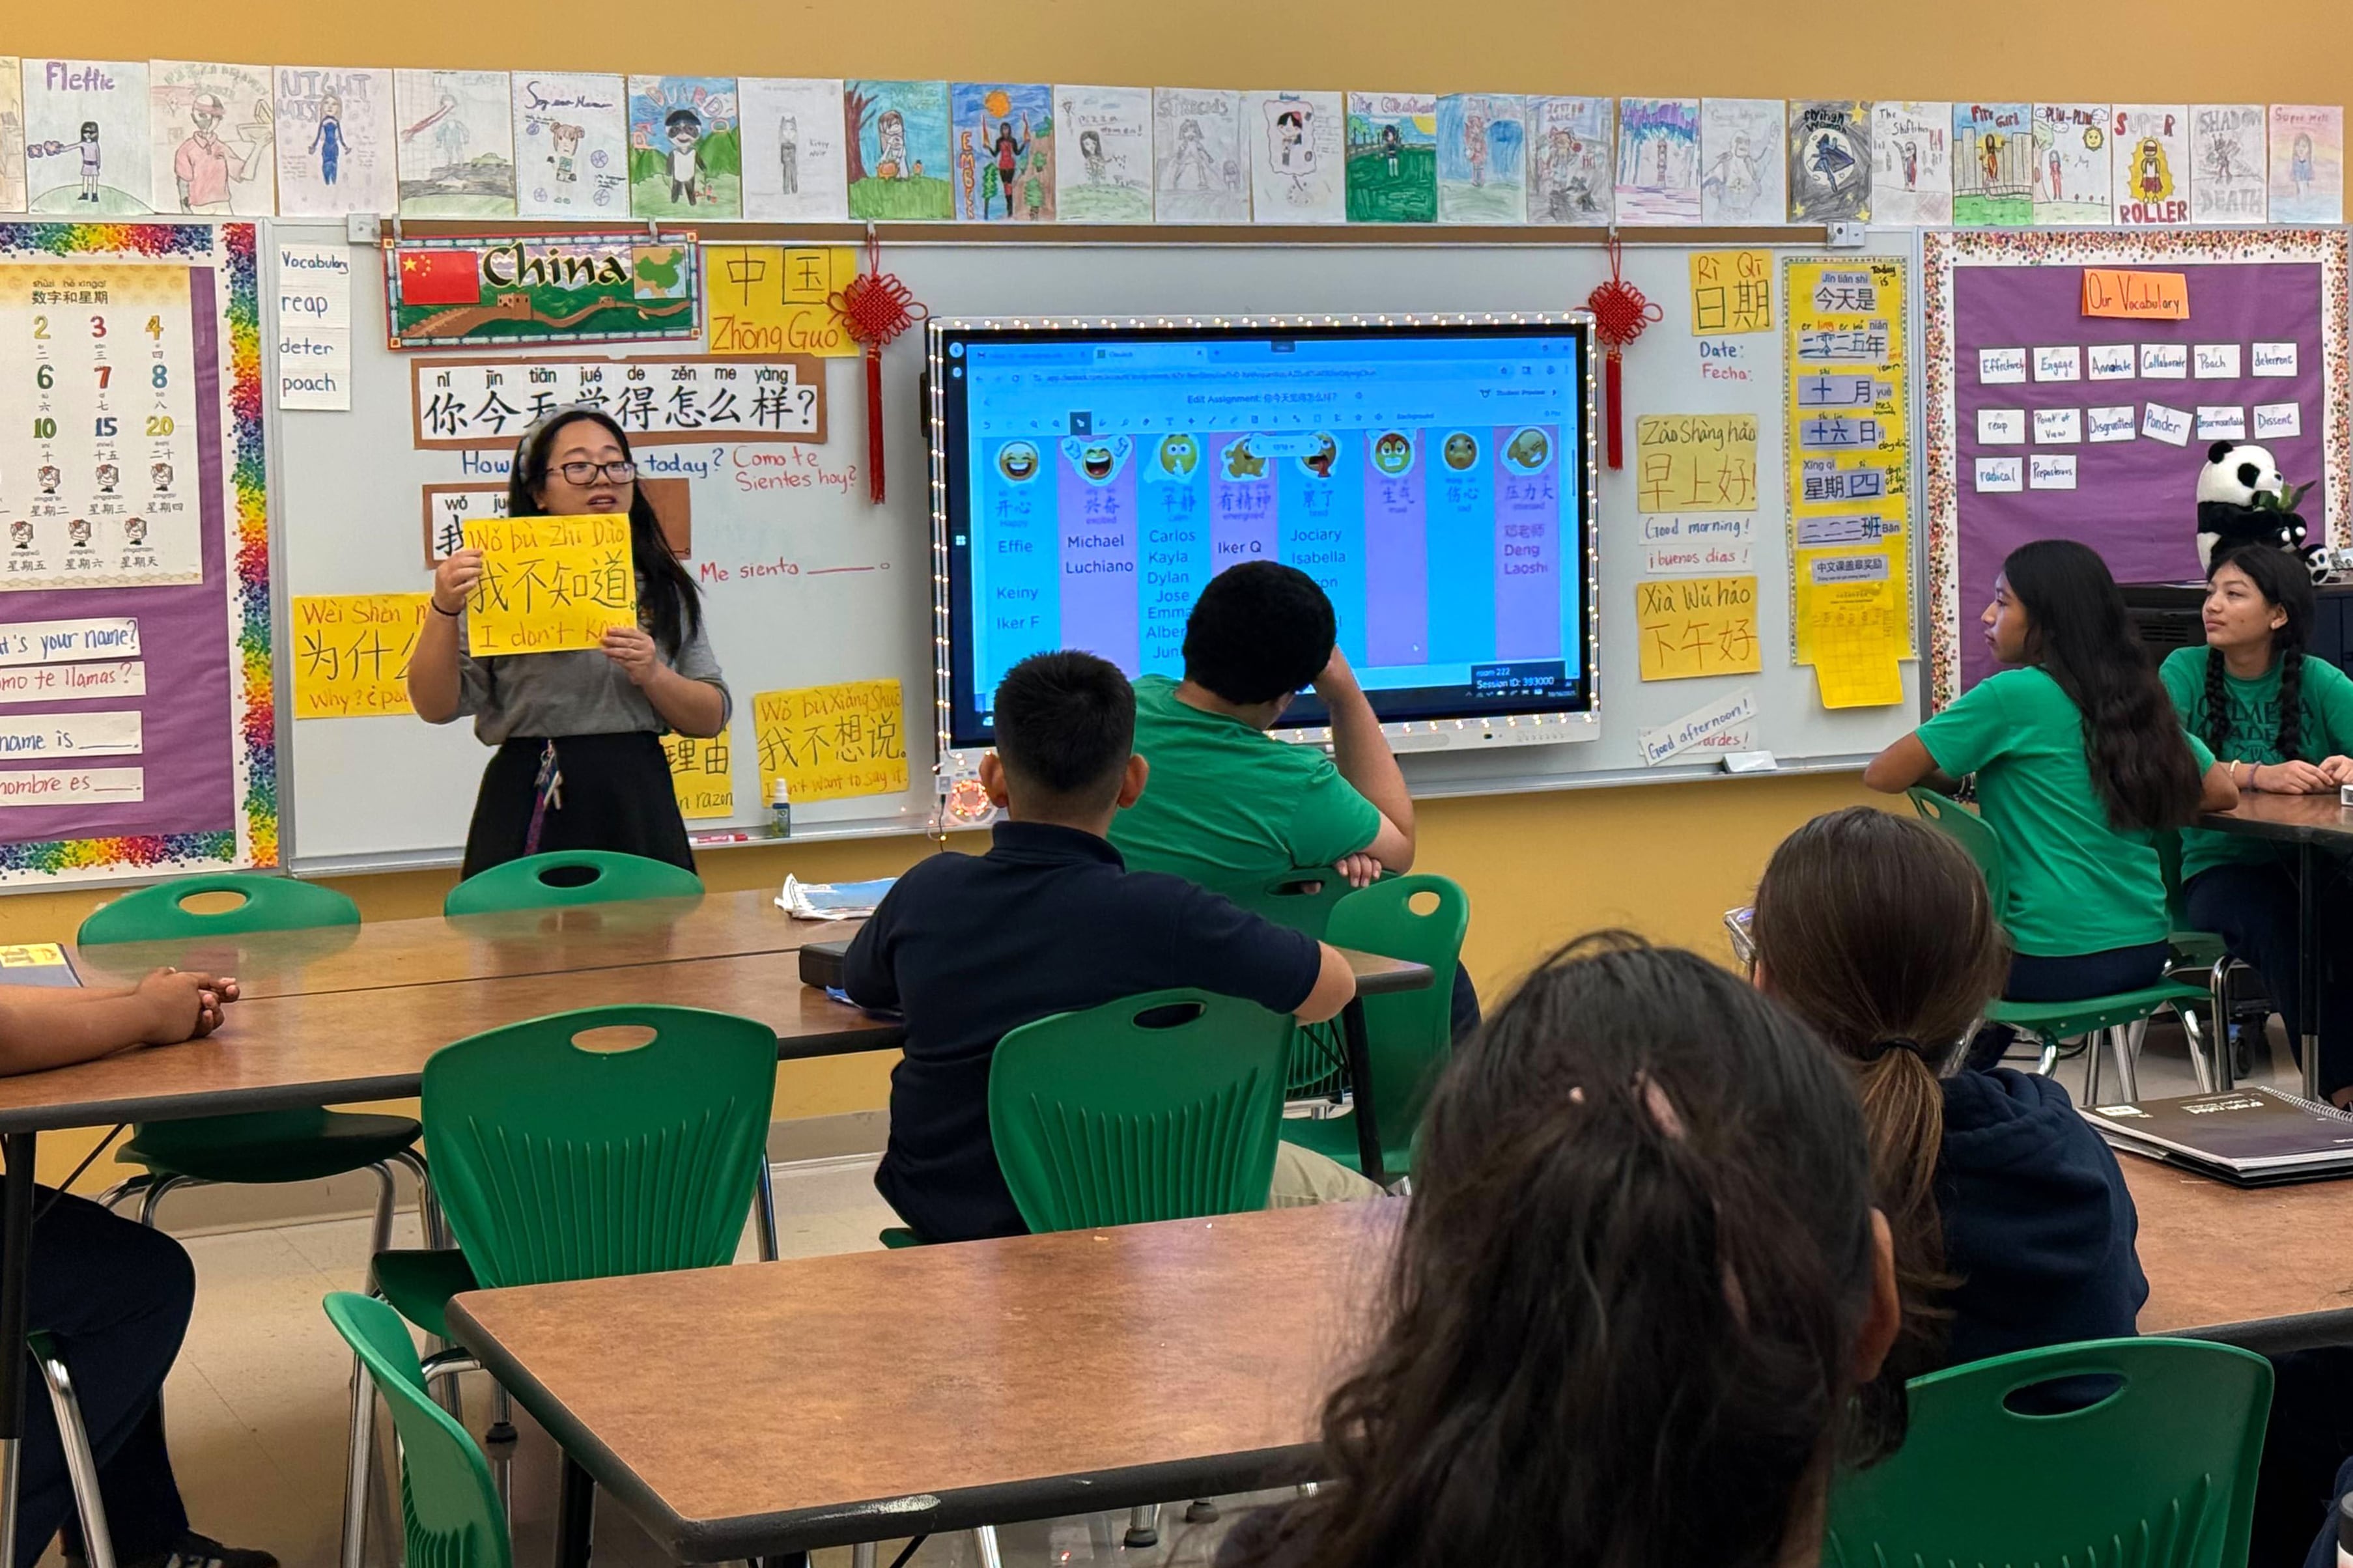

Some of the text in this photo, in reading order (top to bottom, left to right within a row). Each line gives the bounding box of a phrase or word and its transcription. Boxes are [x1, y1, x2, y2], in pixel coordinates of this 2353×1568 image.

[1880, 108, 1896, 119] The
[2120, 201, 2188, 225] ROLLER
[282, 251, 350, 274] Vocabulary
[483, 241, 631, 287] China
[726, 246, 832, 307] 中国
[31, 290, 108, 305] 数字和星期
[1815, 286, 1876, 311] 今天是
[2089, 273, 2180, 314] Our Vocabulary
[281, 295, 328, 318] reap
[1696, 279, 1770, 329] 日期
[34, 315, 164, 340] 2 3 4
[279, 337, 333, 355] deter
[1700, 341, 1743, 358] Date:
[2041, 357, 2074, 377] Engage
[2197, 352, 2226, 369] Poach
[36, 364, 168, 389] 6 7 8
[627, 365, 645, 381] de
[714, 367, 737, 380] me
[1702, 363, 1753, 382] Fecha:
[282, 372, 337, 397] poach
[34, 415, 175, 439] 10 15 20
[2146, 409, 2182, 434] Ponder
[462, 448, 725, 479] How today?
[733, 446, 787, 469] Como
[735, 465, 857, 494] Sientes hoy?
[1980, 467, 2016, 482] radical
[1804, 473, 1881, 501] 星期四
[30, 502, 184, 517] 星期二 星期三 星期四
[1149, 529, 1196, 542] Carlos
[1291, 529, 1342, 543] Jociary
[1646, 517, 1750, 539] Good morning!
[998, 539, 1034, 553] Effie
[1068, 534, 1125, 549] Michael
[1219, 540, 1262, 553] Iker Q
[1504, 544, 1540, 557] Deng
[7, 556, 158, 572] 星期五 星期六 星期天
[1065, 559, 1134, 574] Luchiano
[1149, 551, 1189, 565] Kayla
[1292, 550, 1346, 564] Isabella
[701, 557, 800, 583] Me siento
[1148, 570, 1189, 586] Dylan
[1504, 563, 1549, 575] Laoshi
[997, 587, 1039, 602] Keiny
[1156, 589, 1190, 602] Jose
[997, 615, 1040, 630] Iker F
[42, 619, 137, 660] your name?
[479, 625, 499, 647] I
[1644, 619, 1758, 670] 下午好
[34, 670, 55, 689] te
[1476, 679, 1508, 690] Session
[1648, 698, 1751, 761] Good afternoon!
[0, 730, 74, 751] name is
[664, 737, 728, 774] 理由
[70, 776, 90, 791] es
